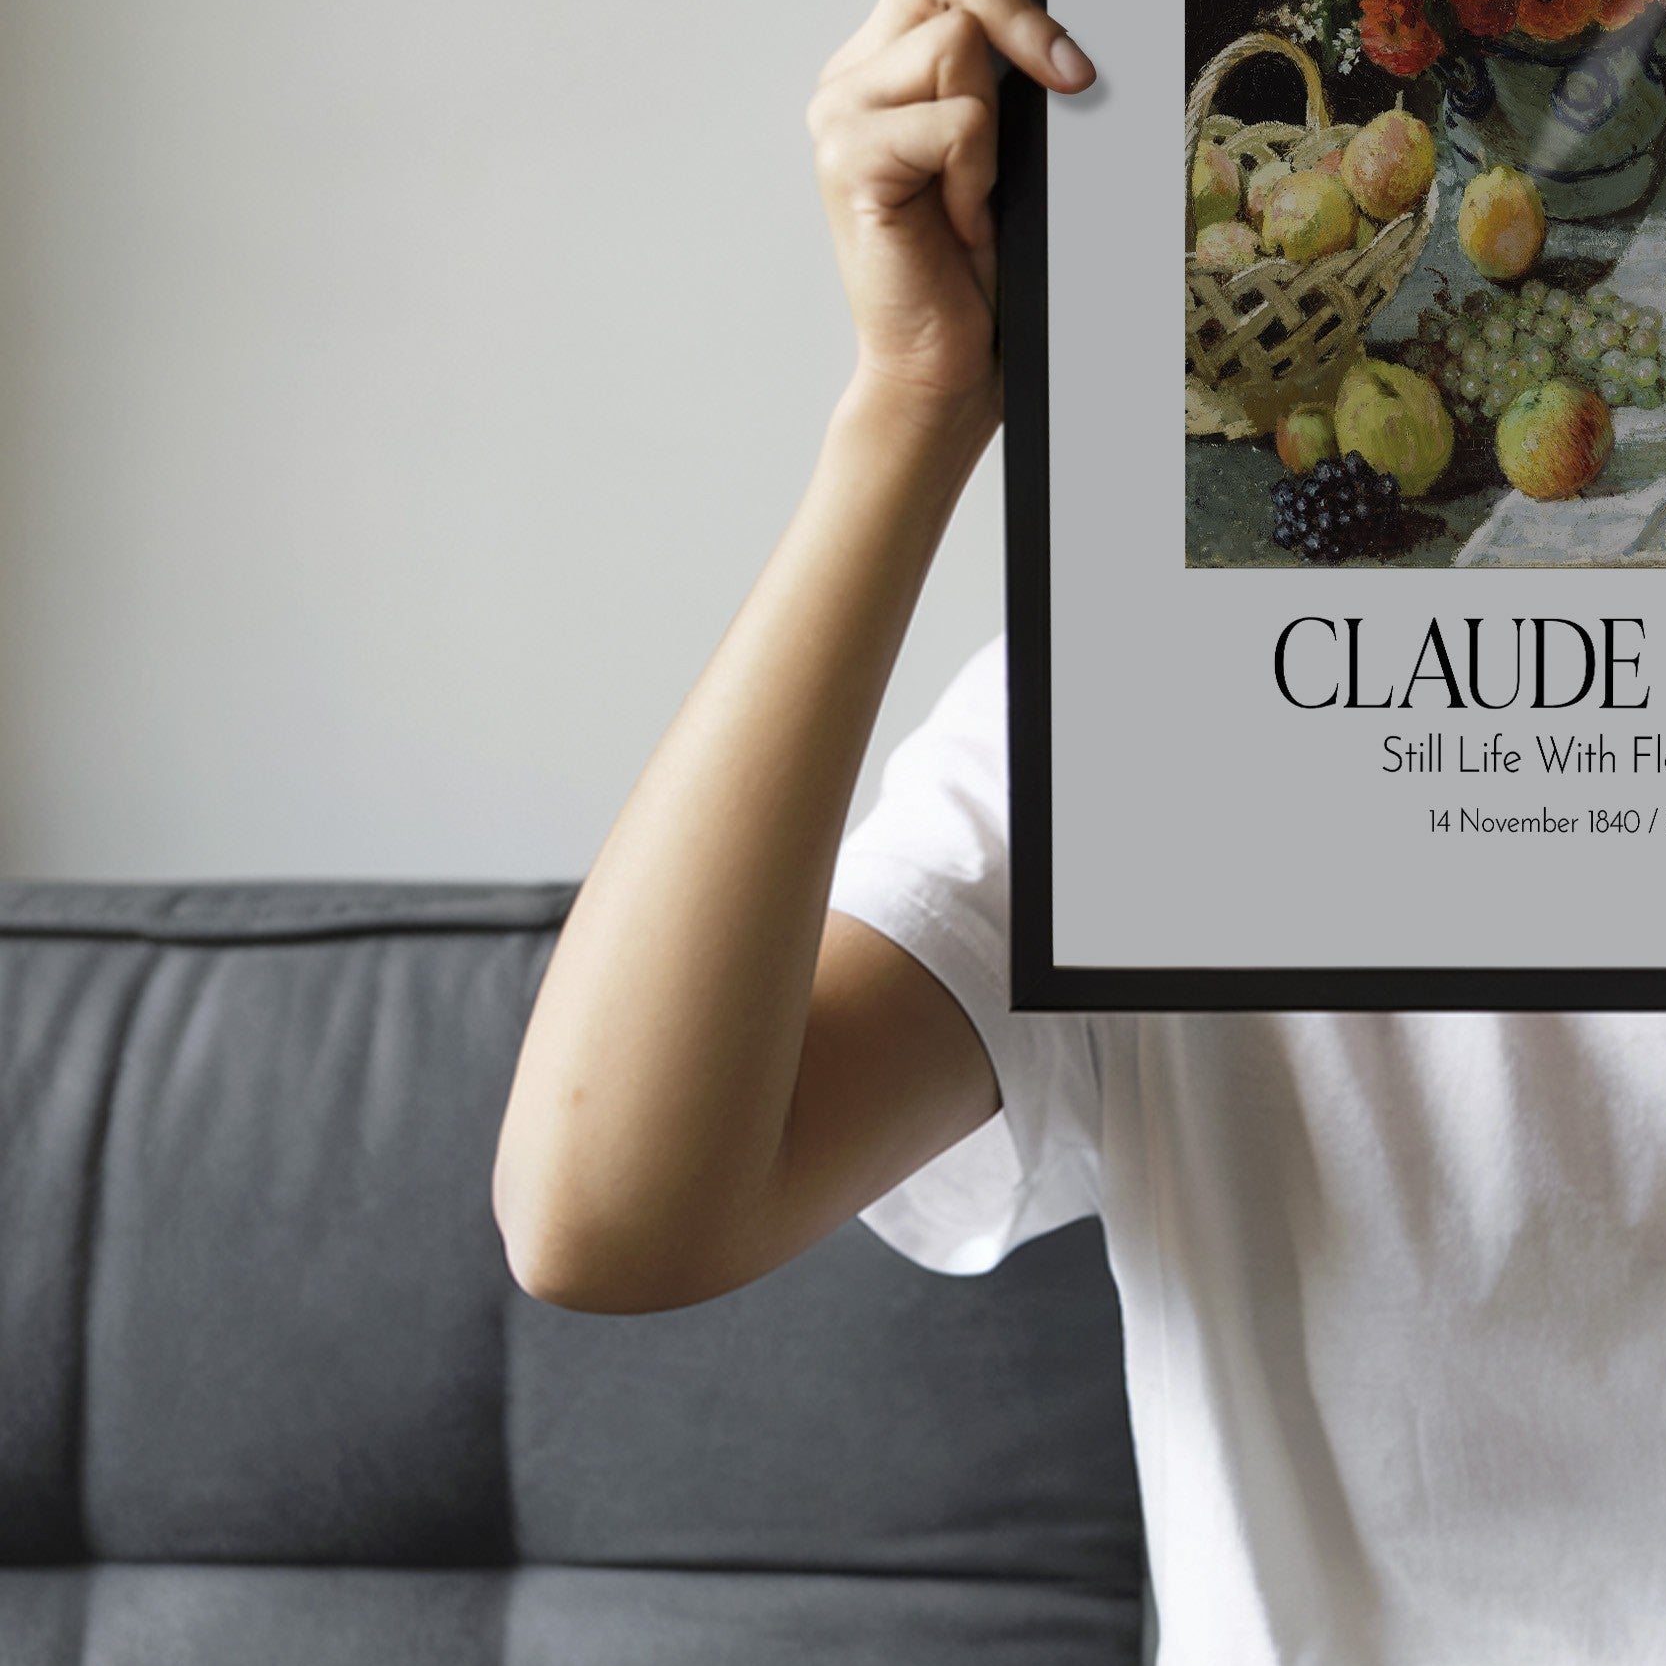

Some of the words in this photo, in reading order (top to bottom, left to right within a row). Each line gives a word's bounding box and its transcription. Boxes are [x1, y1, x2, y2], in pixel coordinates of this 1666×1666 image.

[1273, 616, 1651, 710] CLAUDE
[1382, 732, 1442, 773] Still
[1459, 732, 1522, 774] Life
[1535, 733, 1616, 775] With
[1428, 809, 1452, 833] 14
[1460, 806, 1580, 834] November
[1587, 809, 1641, 834] 1840
[1648, 807, 1659, 834] /
